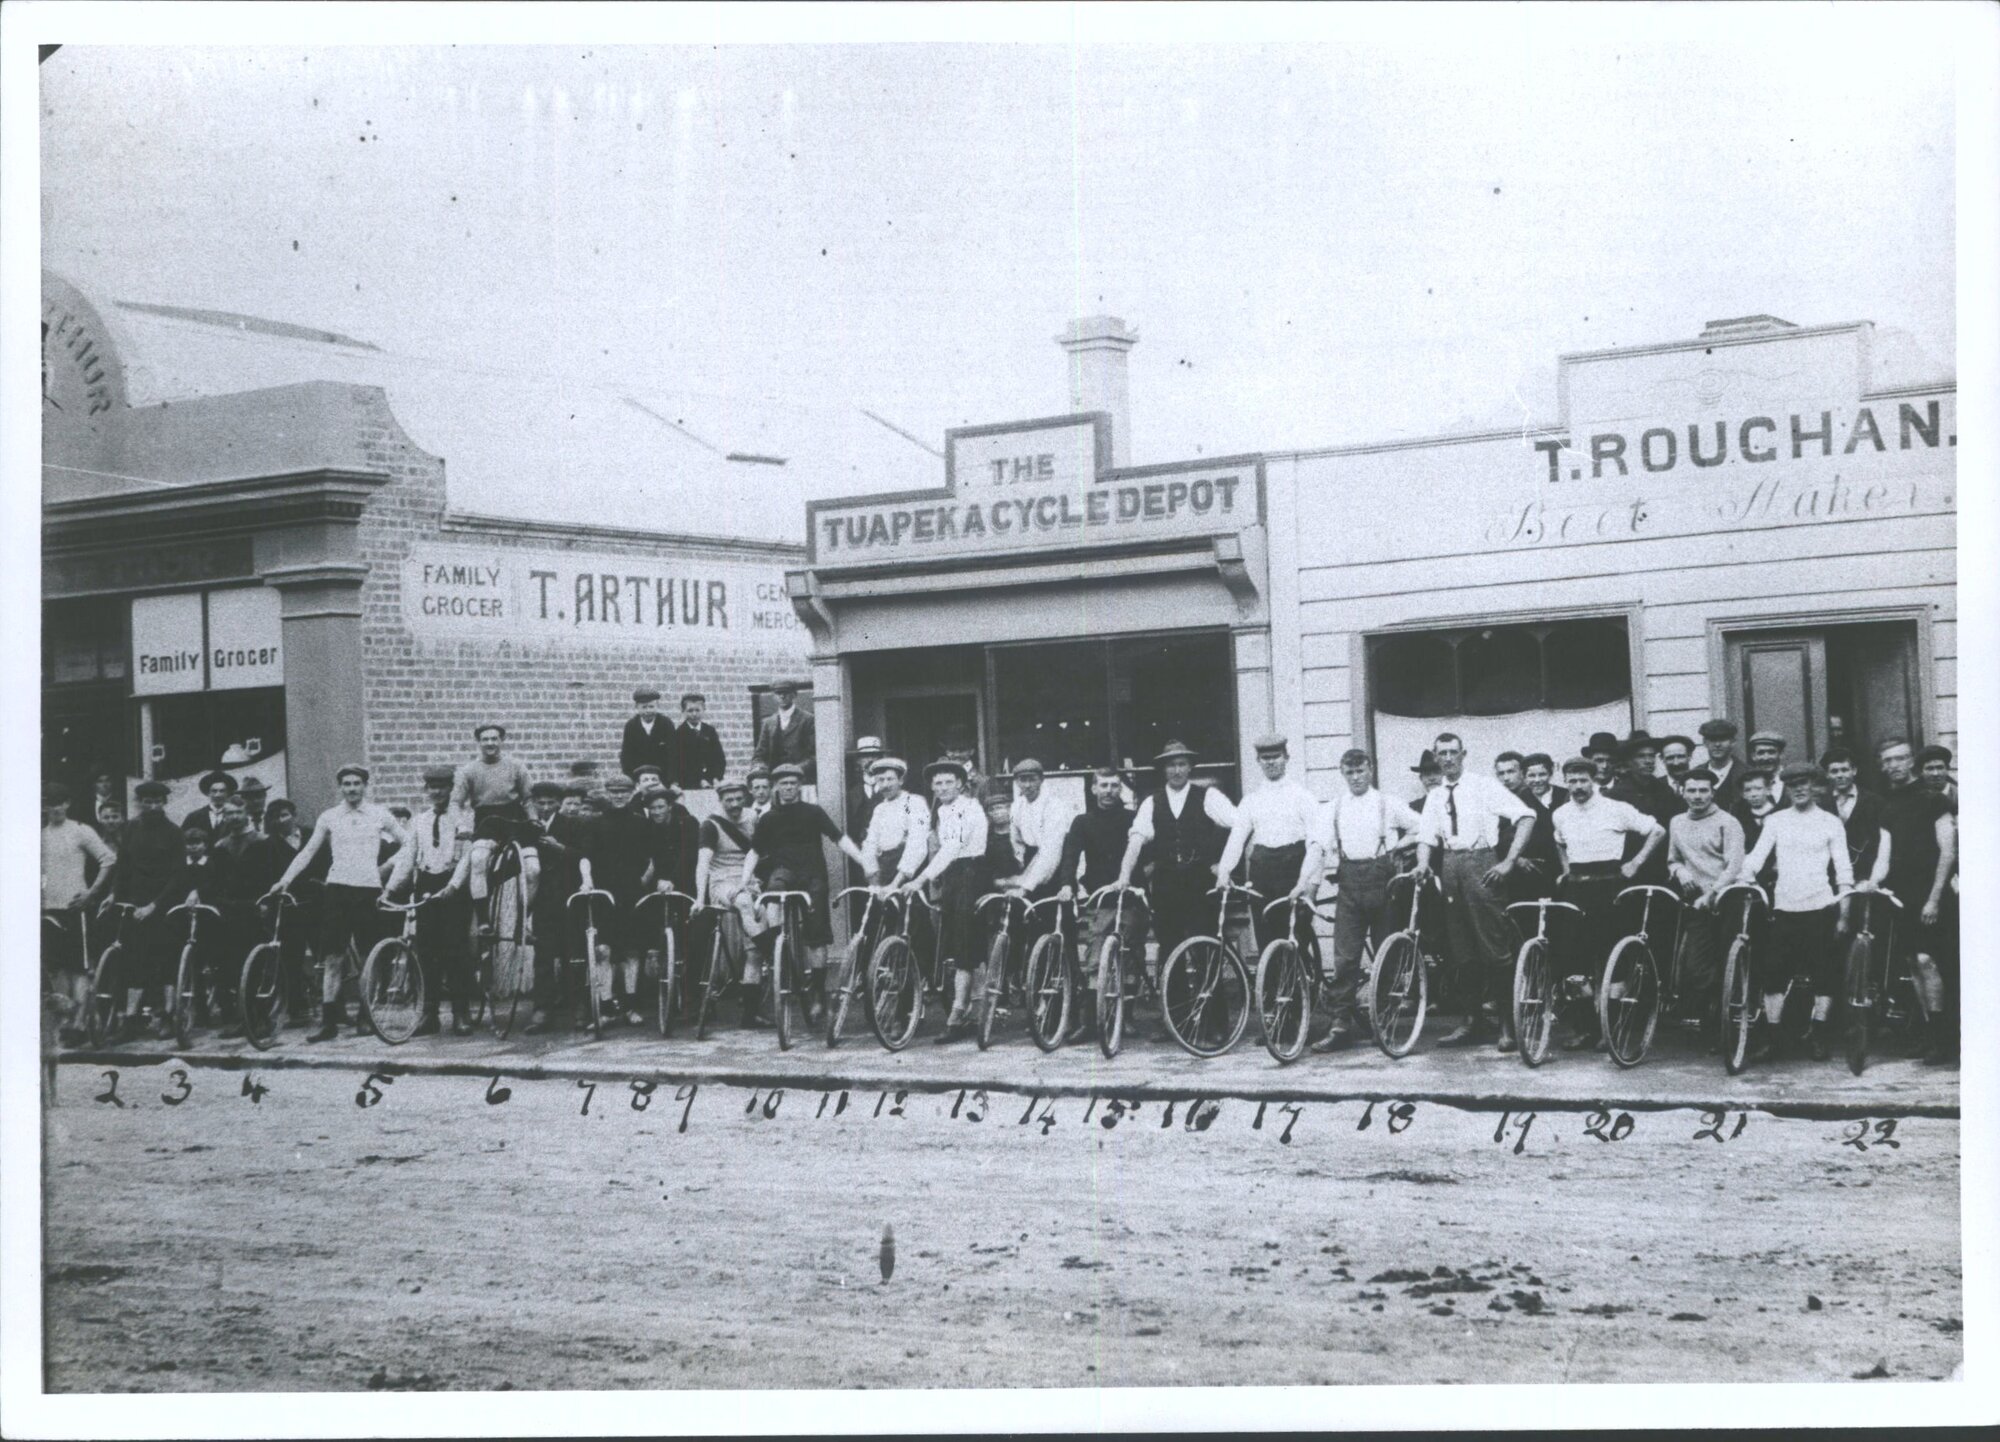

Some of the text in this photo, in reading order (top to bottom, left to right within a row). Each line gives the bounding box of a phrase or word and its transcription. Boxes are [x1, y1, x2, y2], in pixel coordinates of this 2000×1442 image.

[991, 454, 1055, 486] THE
[824, 475, 1240, 547] TUAPEKA CYCLE DEPOT
[423, 564, 500, 587] FAMILY
[422, 595, 503, 617] GROCER
[140, 648, 277, 674] Family Grocer
